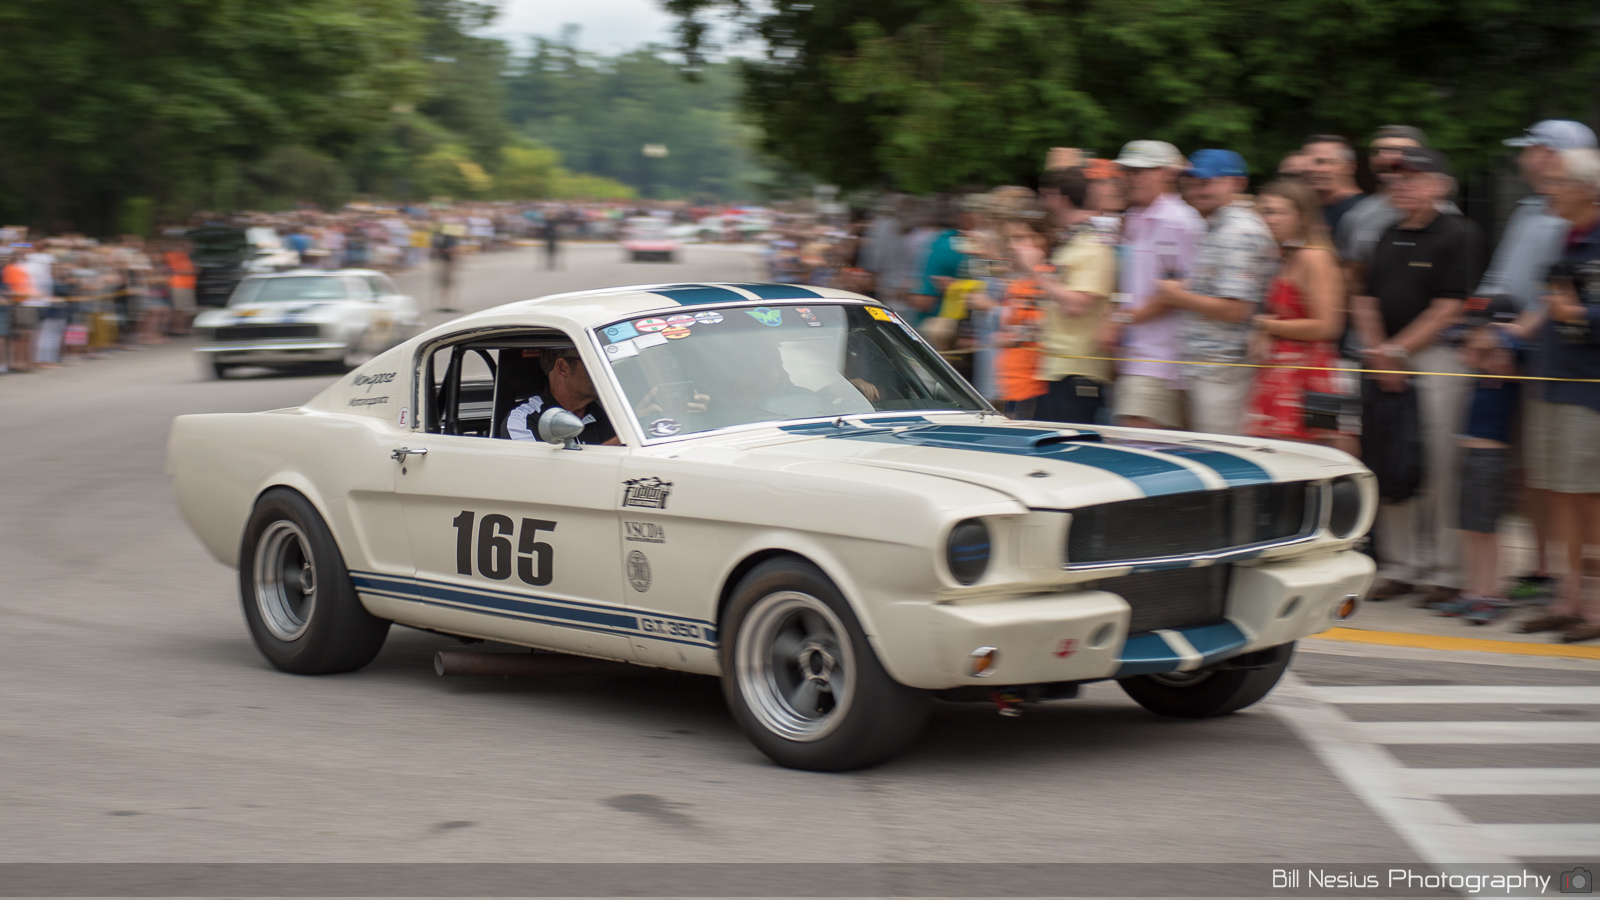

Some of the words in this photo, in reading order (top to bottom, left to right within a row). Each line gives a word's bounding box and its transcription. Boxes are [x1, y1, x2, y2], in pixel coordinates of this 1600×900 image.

[400, 410, 407, 425] E
[624, 521, 665, 538] VSCDA
[452, 510, 557, 586] 165
